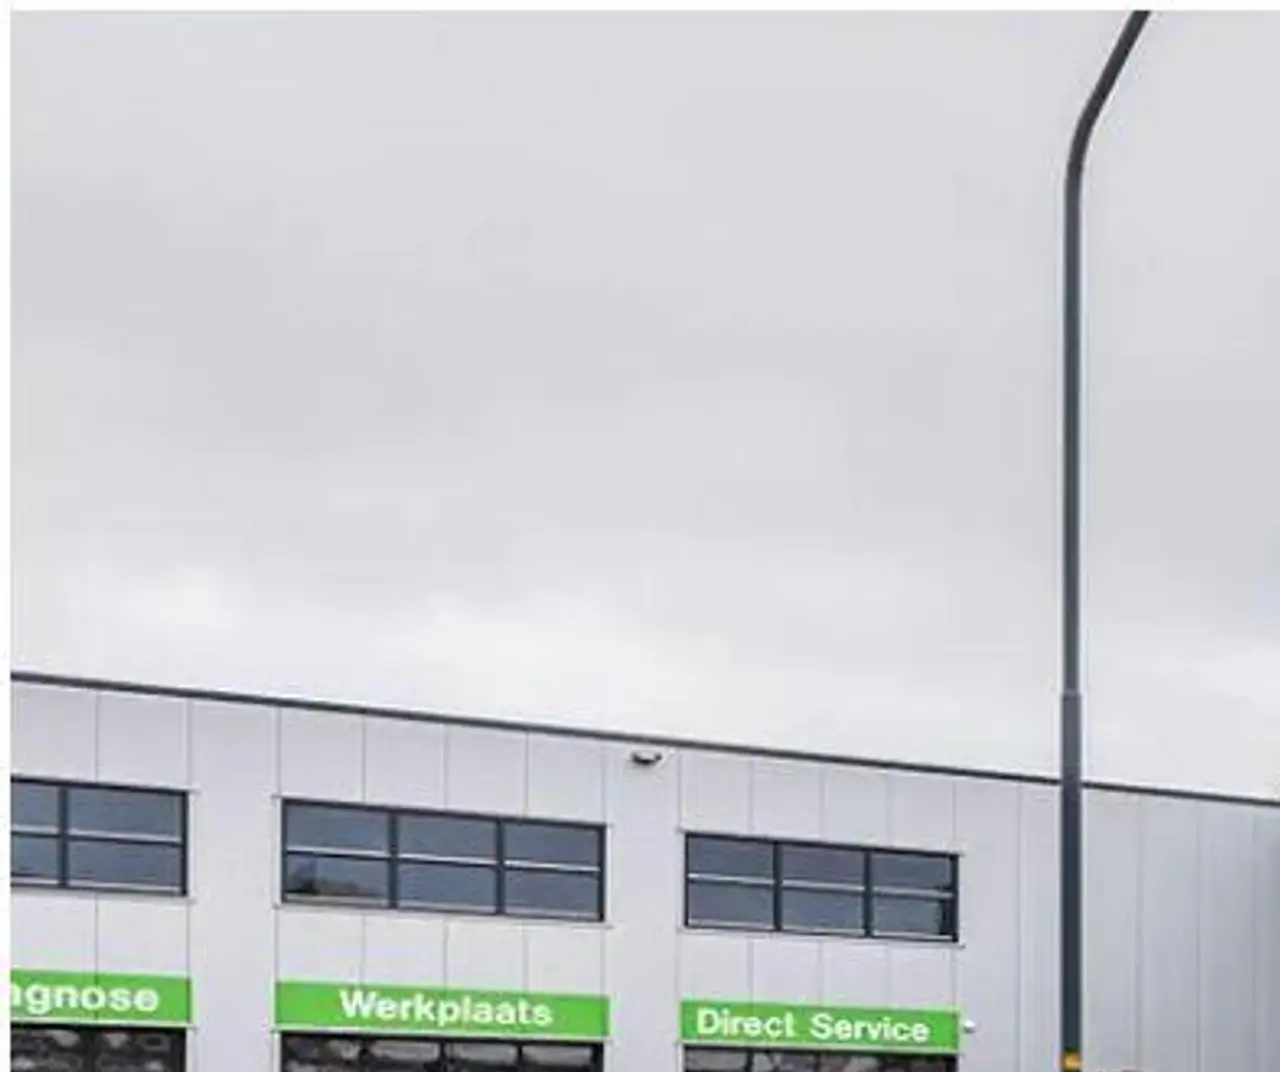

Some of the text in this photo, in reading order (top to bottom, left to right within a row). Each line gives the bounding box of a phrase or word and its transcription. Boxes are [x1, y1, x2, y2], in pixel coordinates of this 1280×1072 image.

[339, 988, 554, 1026] Werkplaats
[697, 1007, 931, 1043] Direct Service
